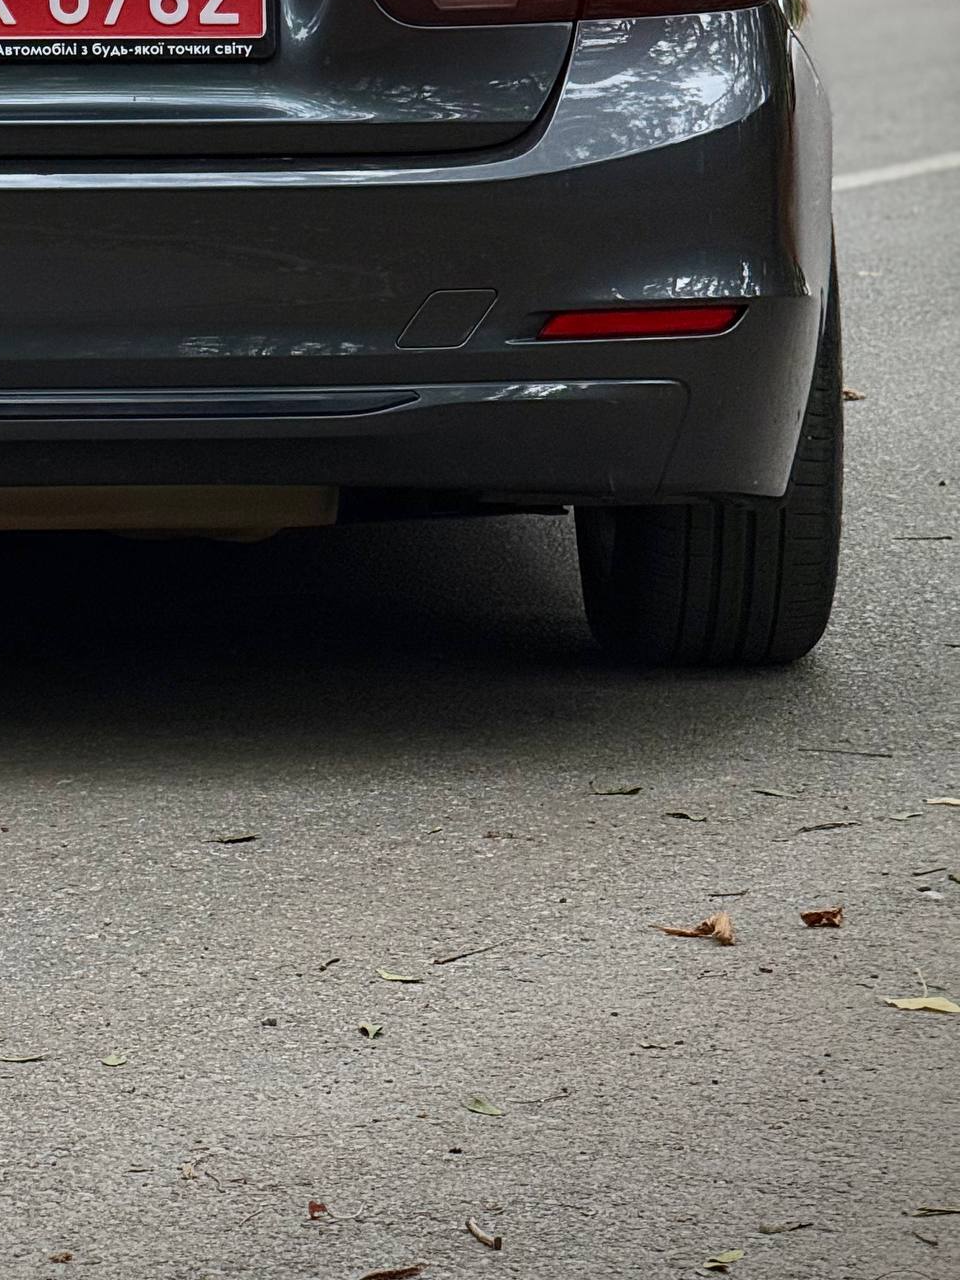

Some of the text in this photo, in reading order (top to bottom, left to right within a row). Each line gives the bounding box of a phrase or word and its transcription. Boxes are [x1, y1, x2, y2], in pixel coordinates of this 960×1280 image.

[92, 43, 163, 58] будь-якої
[167, 44, 210, 55] точки
[214, 43, 253, 57] світу
